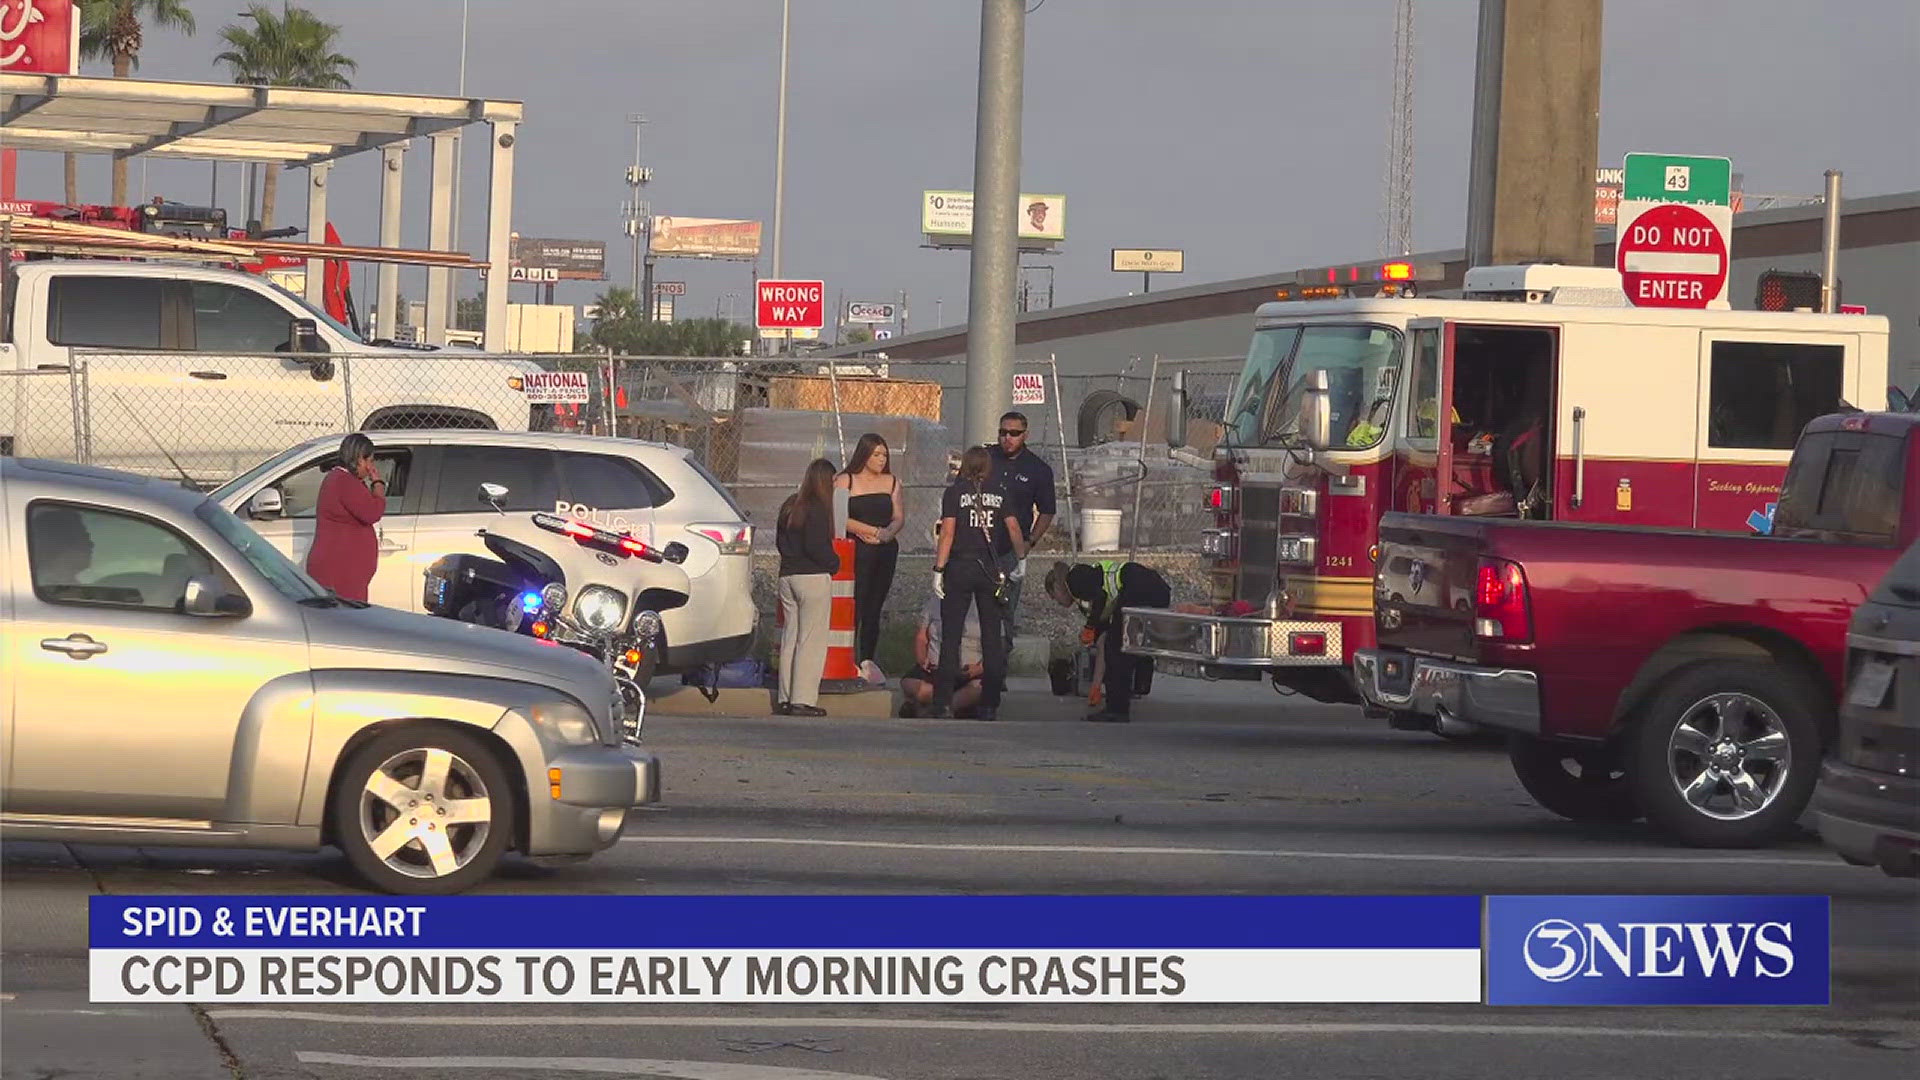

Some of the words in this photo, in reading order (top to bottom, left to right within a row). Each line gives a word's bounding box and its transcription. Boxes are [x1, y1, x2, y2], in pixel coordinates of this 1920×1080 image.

[1667, 175, 1687, 189] 43
[1634, 226, 1660, 245] DO
[1673, 227, 1713, 247] NOT
[761, 287, 819, 302] WRONG
[1639, 280, 1703, 299] ENTER
[772, 306, 808, 321] WAY
[525, 373, 586, 388] NATIONAL
[1326, 556, 1353, 567] 1241
